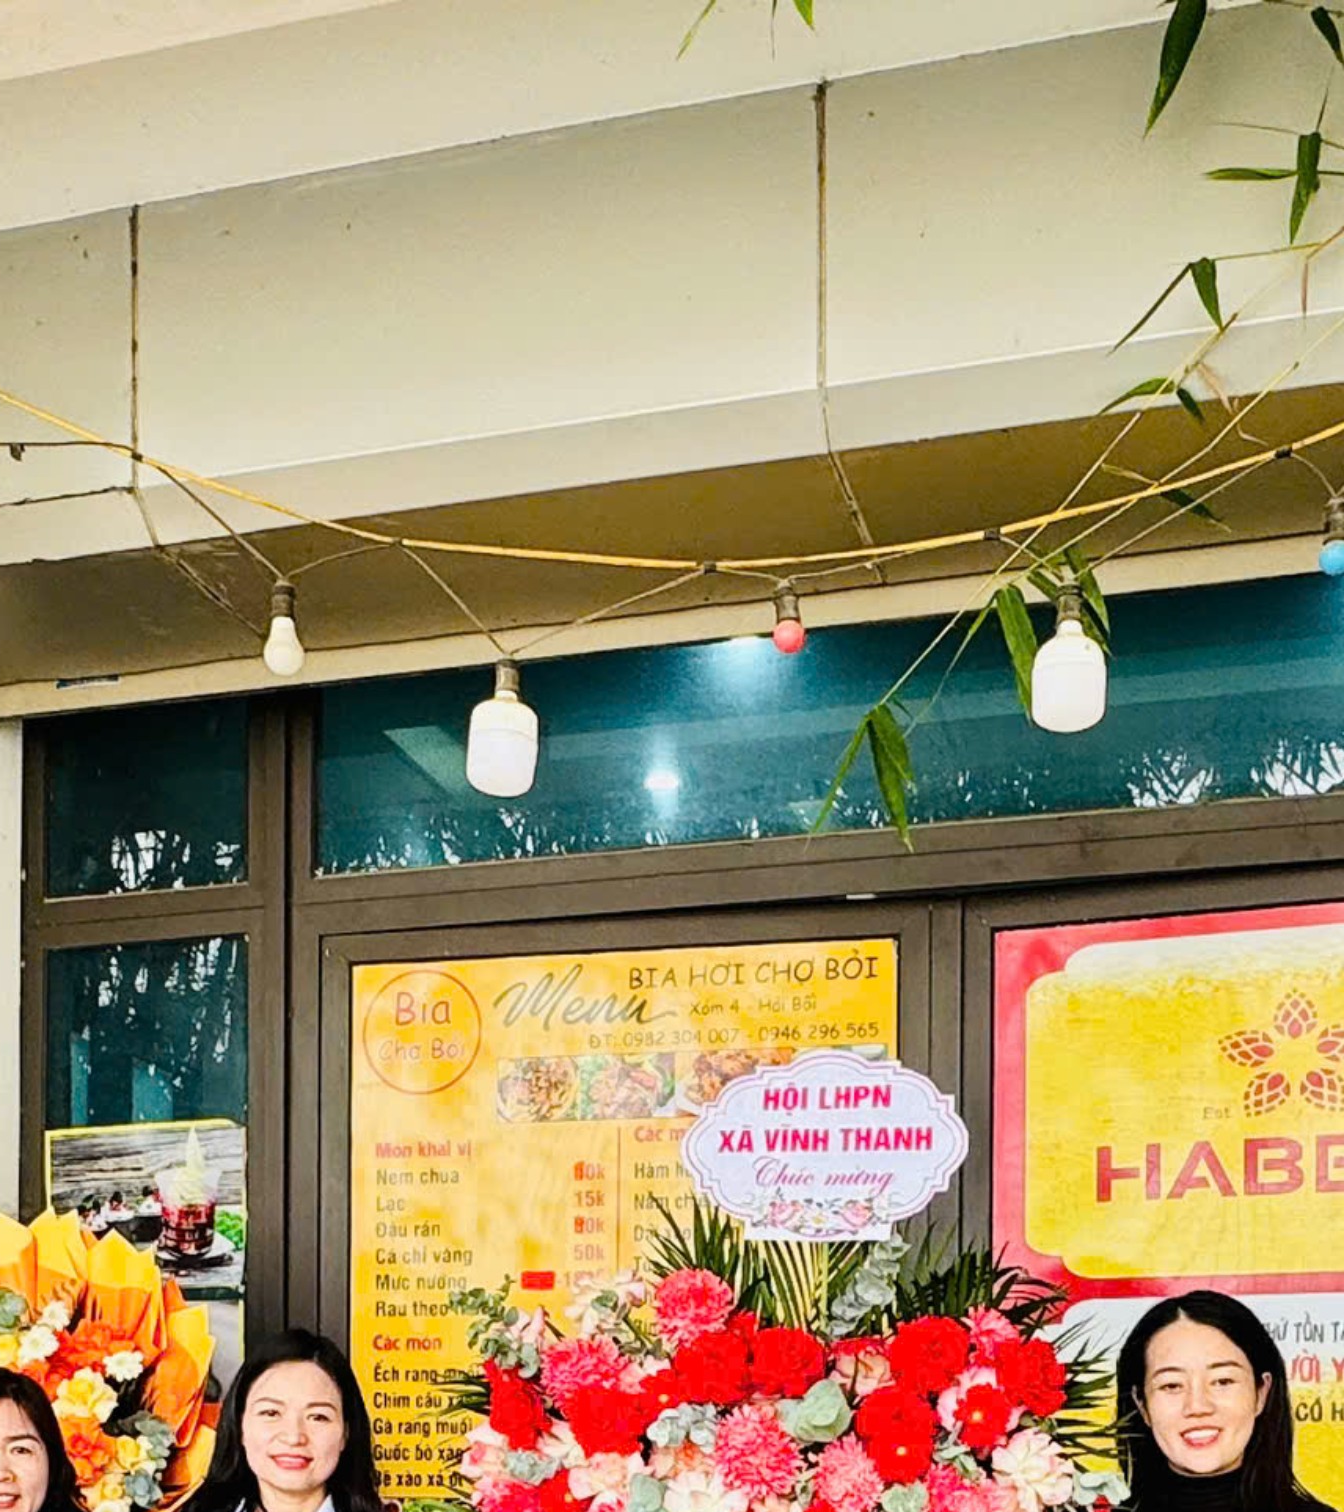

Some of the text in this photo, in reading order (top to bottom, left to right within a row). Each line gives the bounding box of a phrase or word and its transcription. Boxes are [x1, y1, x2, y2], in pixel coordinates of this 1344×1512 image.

[629, 967, 678, 990] BIA
[689, 961, 744, 987] HƠI
[395, 991, 452, 1026] Bia
[493, 963, 678, 1032] Menu
[708, 1027, 740, 1043] 007
[758, 1025, 801, 1043] 0946
[808, 1022, 840, 1040] 296
[846, 1021, 879, 1038] 565
[762, 1082, 892, 1116] HỘI LHPN
[718, 1124, 753, 1153] XÃ
[764, 1123, 830, 1152] VĨNH
[839, 1126, 934, 1151] THANH
[376, 1168, 459, 1185] Nem chua
[752, 1155, 895, 1194] Chúc mừng
[574, 1190, 605, 1208] 15k
[573, 1244, 605, 1261] 50k
[375, 1301, 407, 1317] Rau
[373, 1391, 410, 1409] Chim
[1295, 1396, 1323, 1422] CÓ
[398, 1421, 431, 1438] rang
